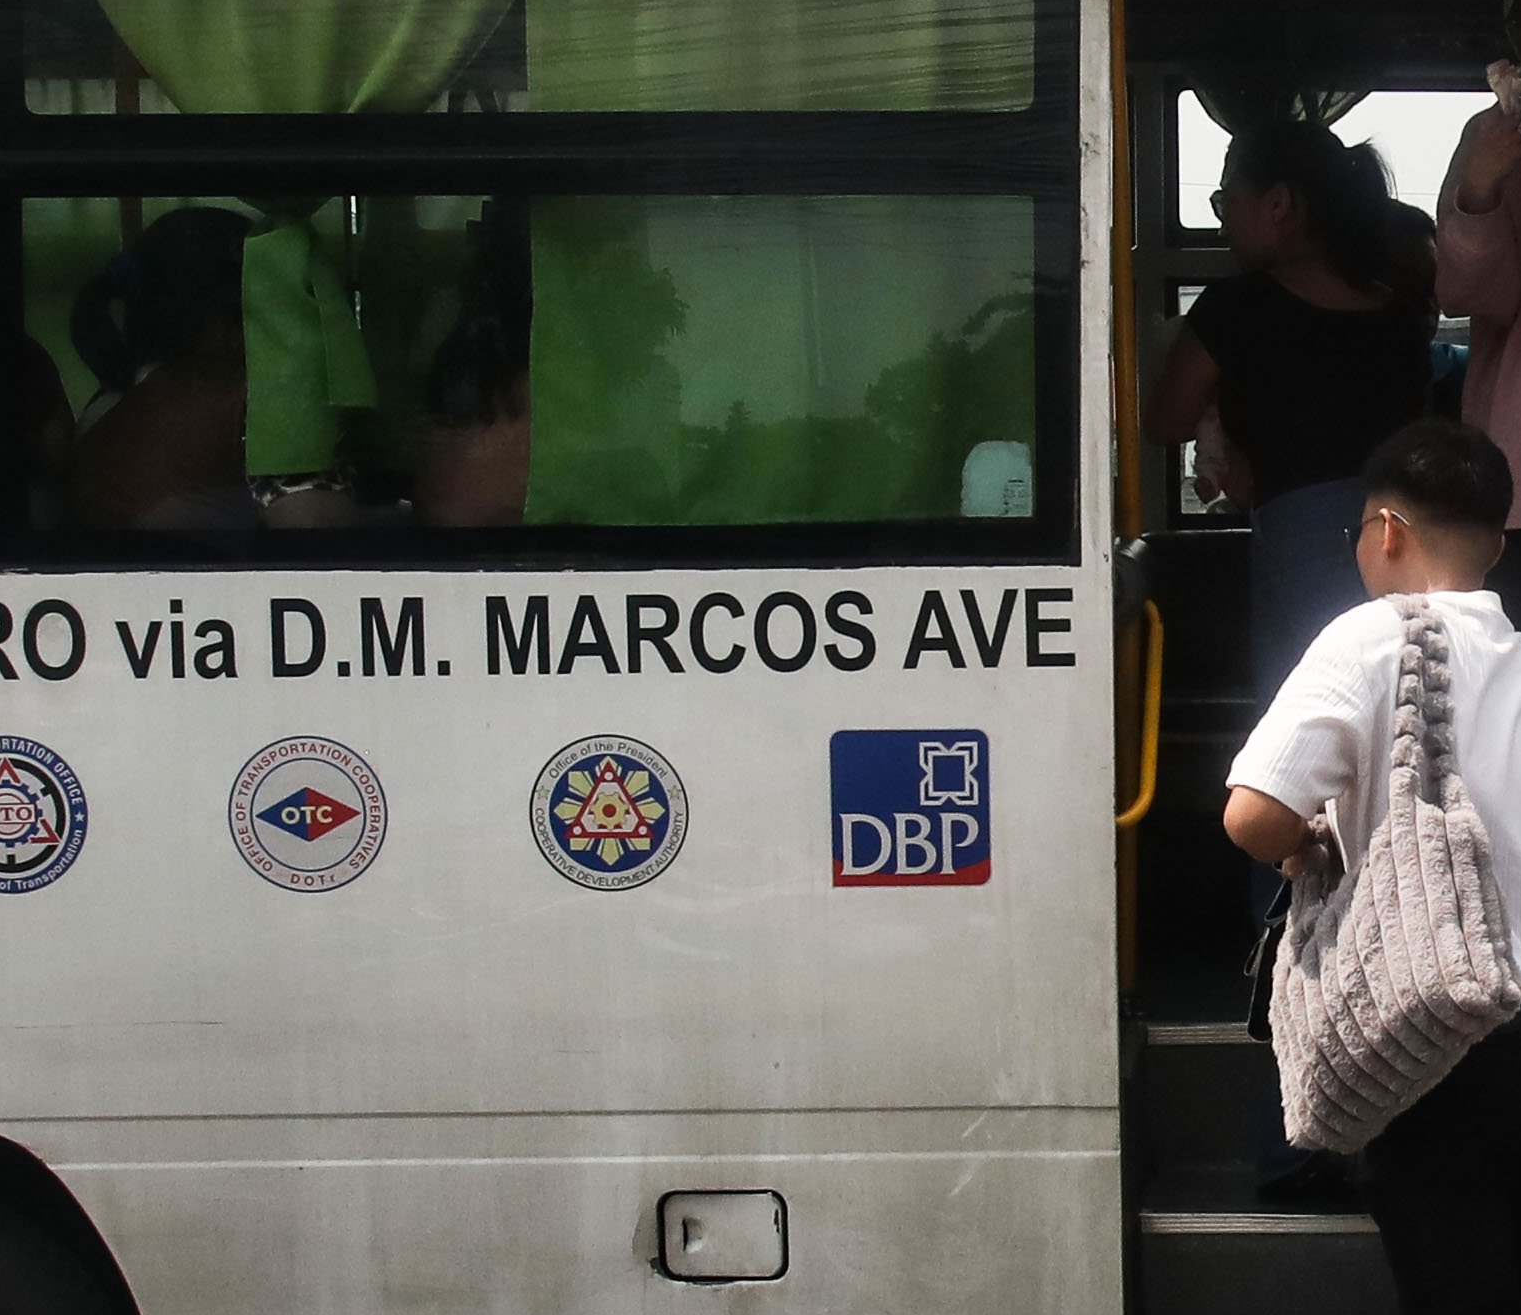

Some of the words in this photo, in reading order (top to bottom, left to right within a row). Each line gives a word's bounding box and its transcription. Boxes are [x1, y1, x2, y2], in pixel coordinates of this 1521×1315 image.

[115, 598, 237, 680] via
[269, 596, 451, 679] D.M.
[484, 588, 876, 677] MARCOS
[902, 586, 1076, 671] AVE
[53, 761, 83, 805] OFFICE
[237, 742, 352, 798] TRANSPORTATION
[549, 751, 579, 779] Office
[580, 744, 592, 755] of
[595, 742, 614, 752] the
[617, 742, 668, 779] President
[235, 801, 247, 821] OF
[281, 805, 333, 825] OTC
[352, 764, 381, 870] COOPERATIVES
[0, 880, 12, 891] of
[15, 830, 83, 890] Transportation
[237, 825, 274, 872] OFFICE
[534, 807, 578, 876] COOPERATIVE
[577, 866, 655, 887] DEVELOPMENT
[655, 811, 684, 868] AUTHORITY
[838, 812, 980, 876] DBP
